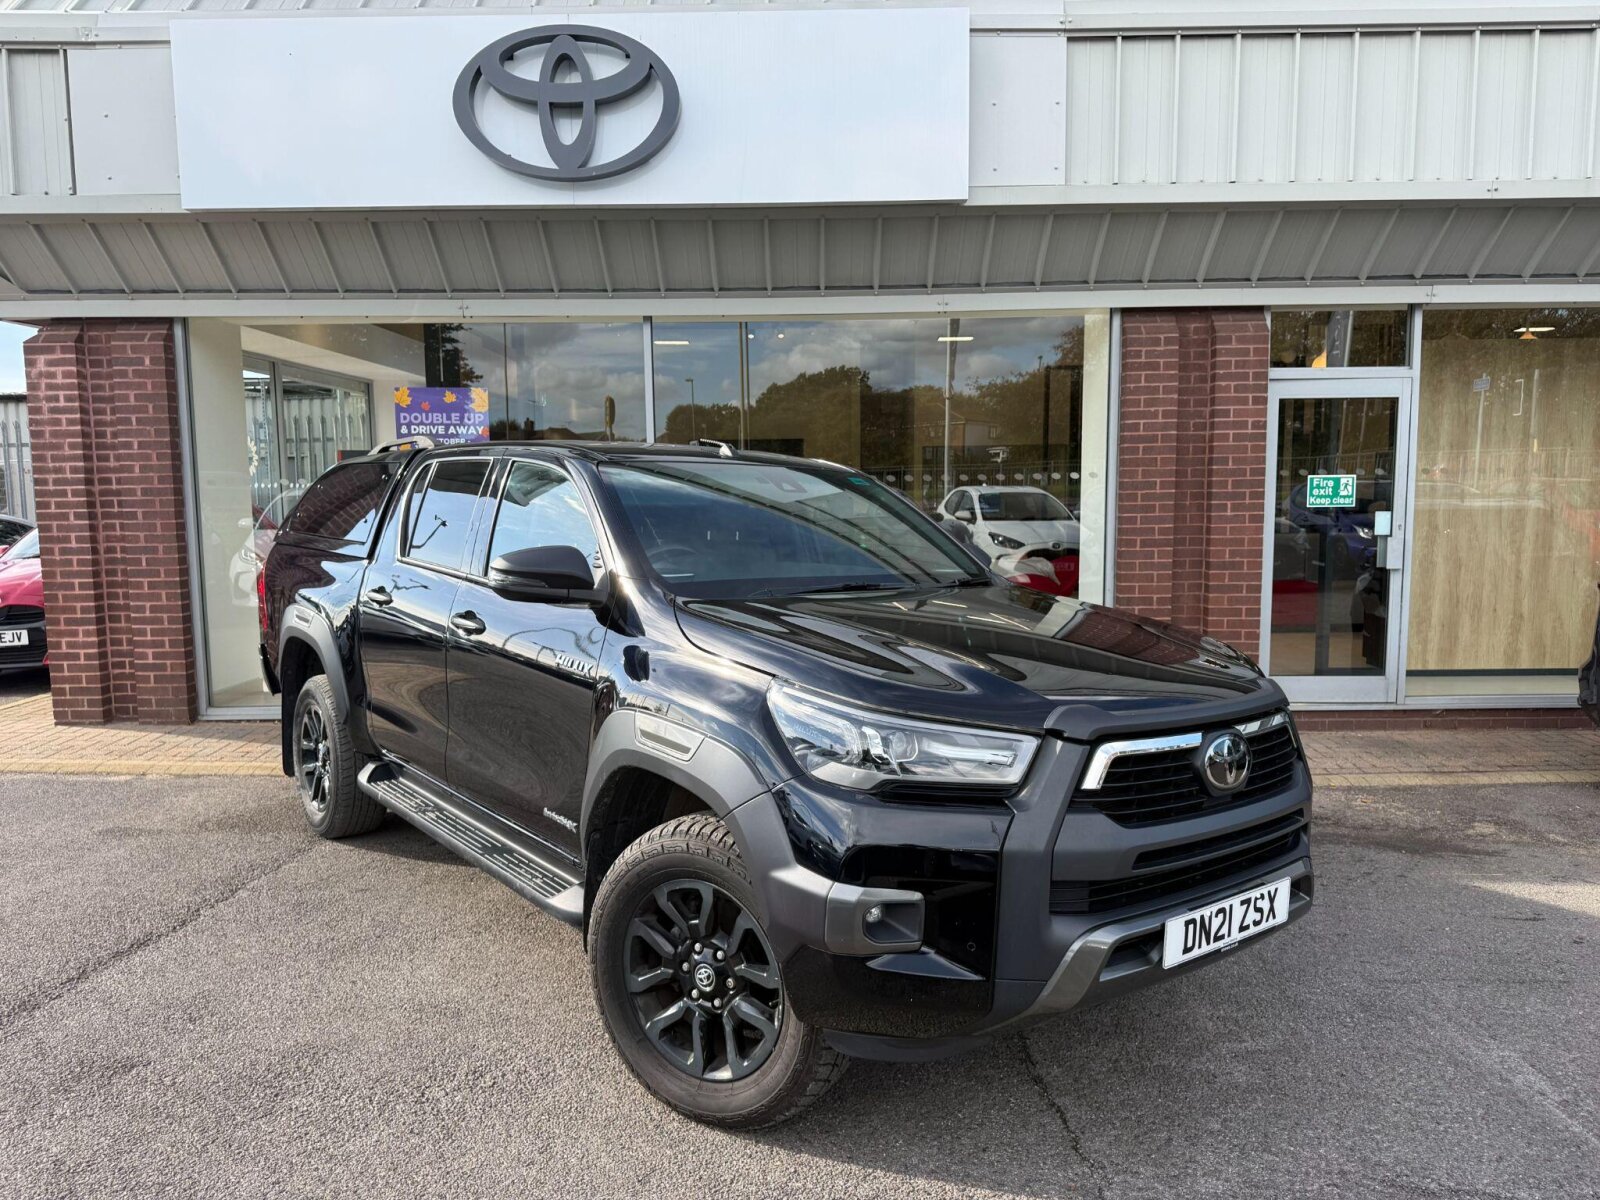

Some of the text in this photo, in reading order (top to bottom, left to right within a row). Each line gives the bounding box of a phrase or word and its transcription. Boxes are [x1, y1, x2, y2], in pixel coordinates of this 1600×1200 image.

[400, 411, 485, 424] DOUBLE UP
[400, 425, 483, 434] & DRIVE AWAY
[1313, 478, 1334, 487] Fire
[1312, 486, 1333, 496] exit
[1309, 496, 1353, 506] Keep clear
[555, 653, 594, 676] HILUX
[1182, 887, 1278, 956] DN21 ZSX
